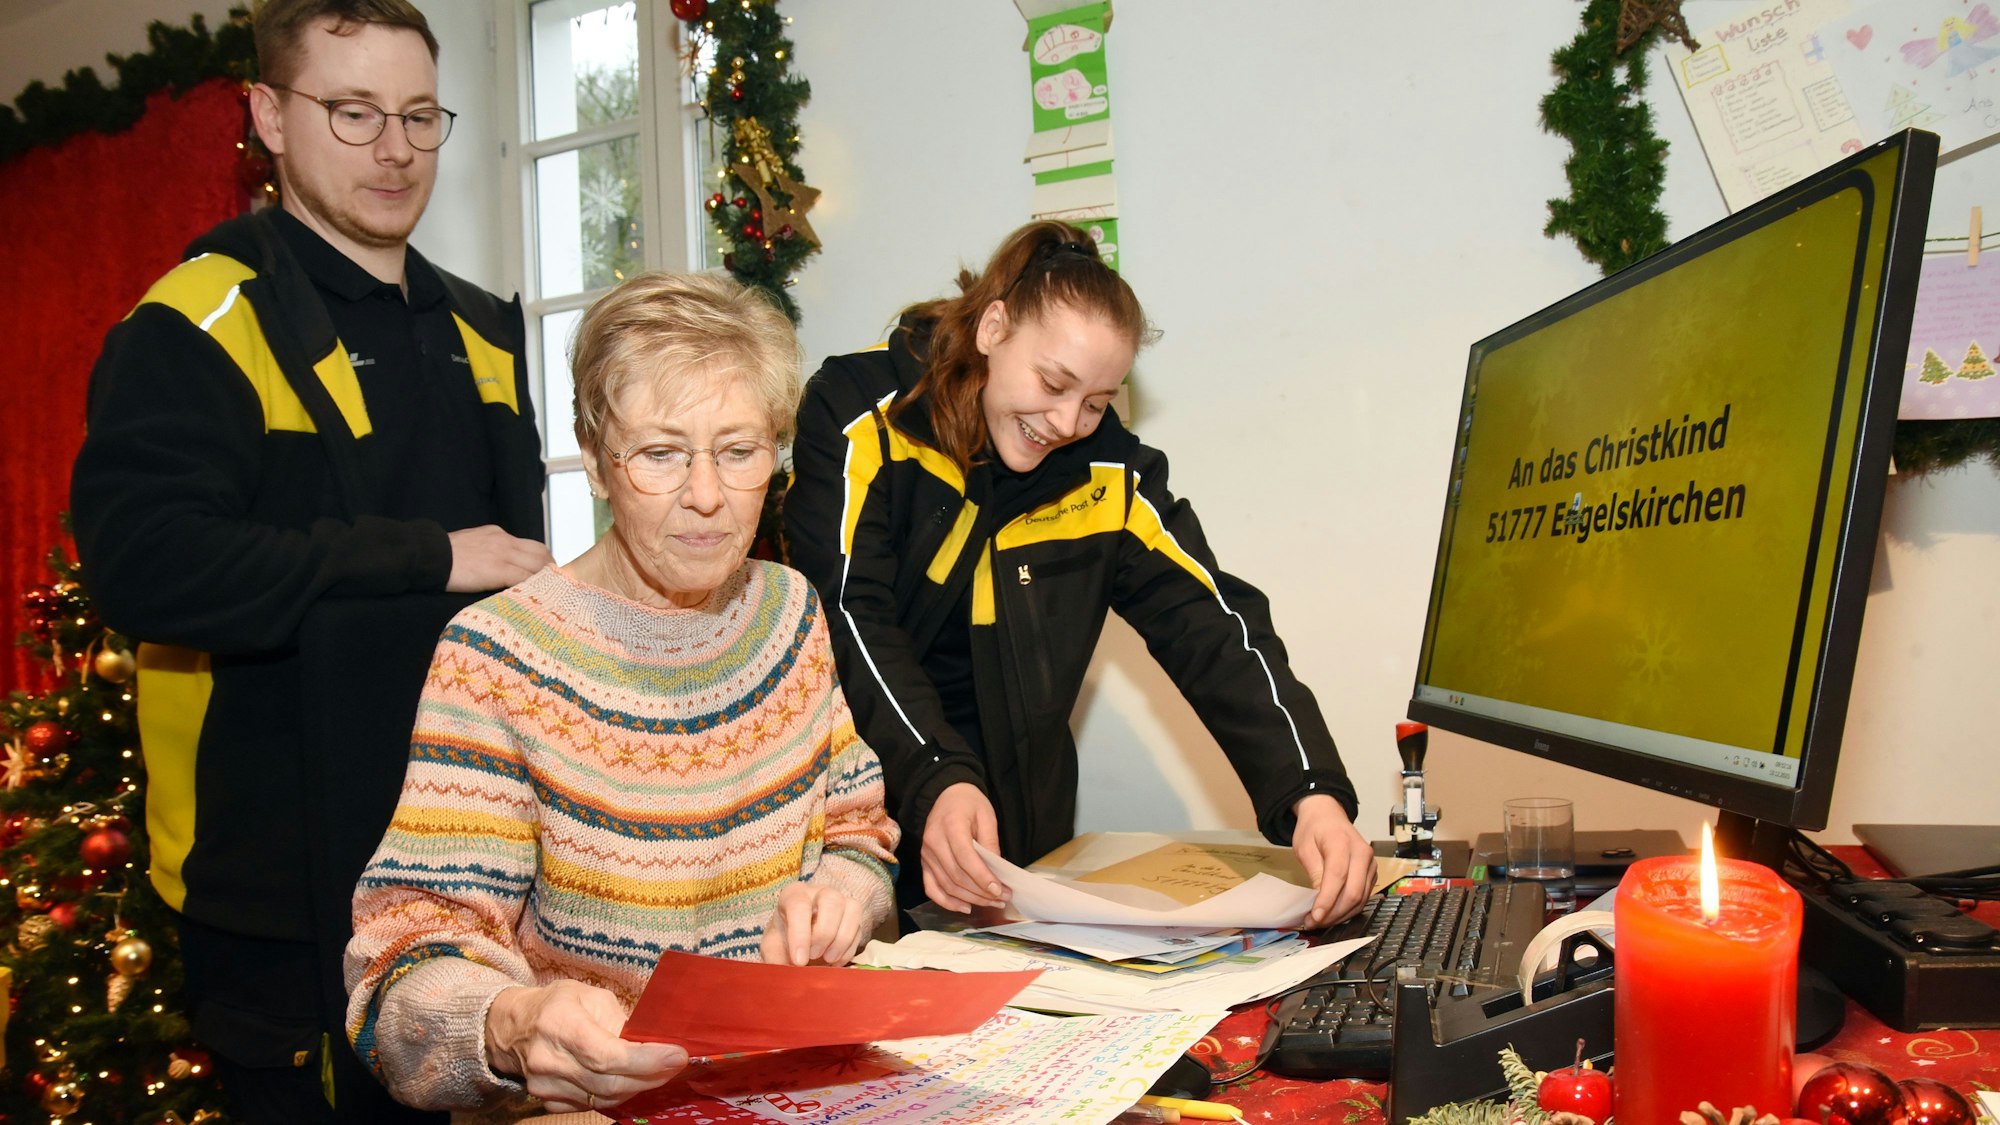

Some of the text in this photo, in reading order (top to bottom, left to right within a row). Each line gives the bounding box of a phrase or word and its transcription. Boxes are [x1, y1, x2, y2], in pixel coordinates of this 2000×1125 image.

[1715, 0, 1801, 42] Wunsch
[1509, 404, 1731, 489] An das Christkind
[1025, 500, 1089, 525] Deutsche Post
[1486, 480, 1747, 544] 51777 Engelskirchen
[1142, 1014, 1219, 1068] Liebes
[904, 1058, 976, 1088] Frieden
[1096, 1076, 1116, 1089] es
